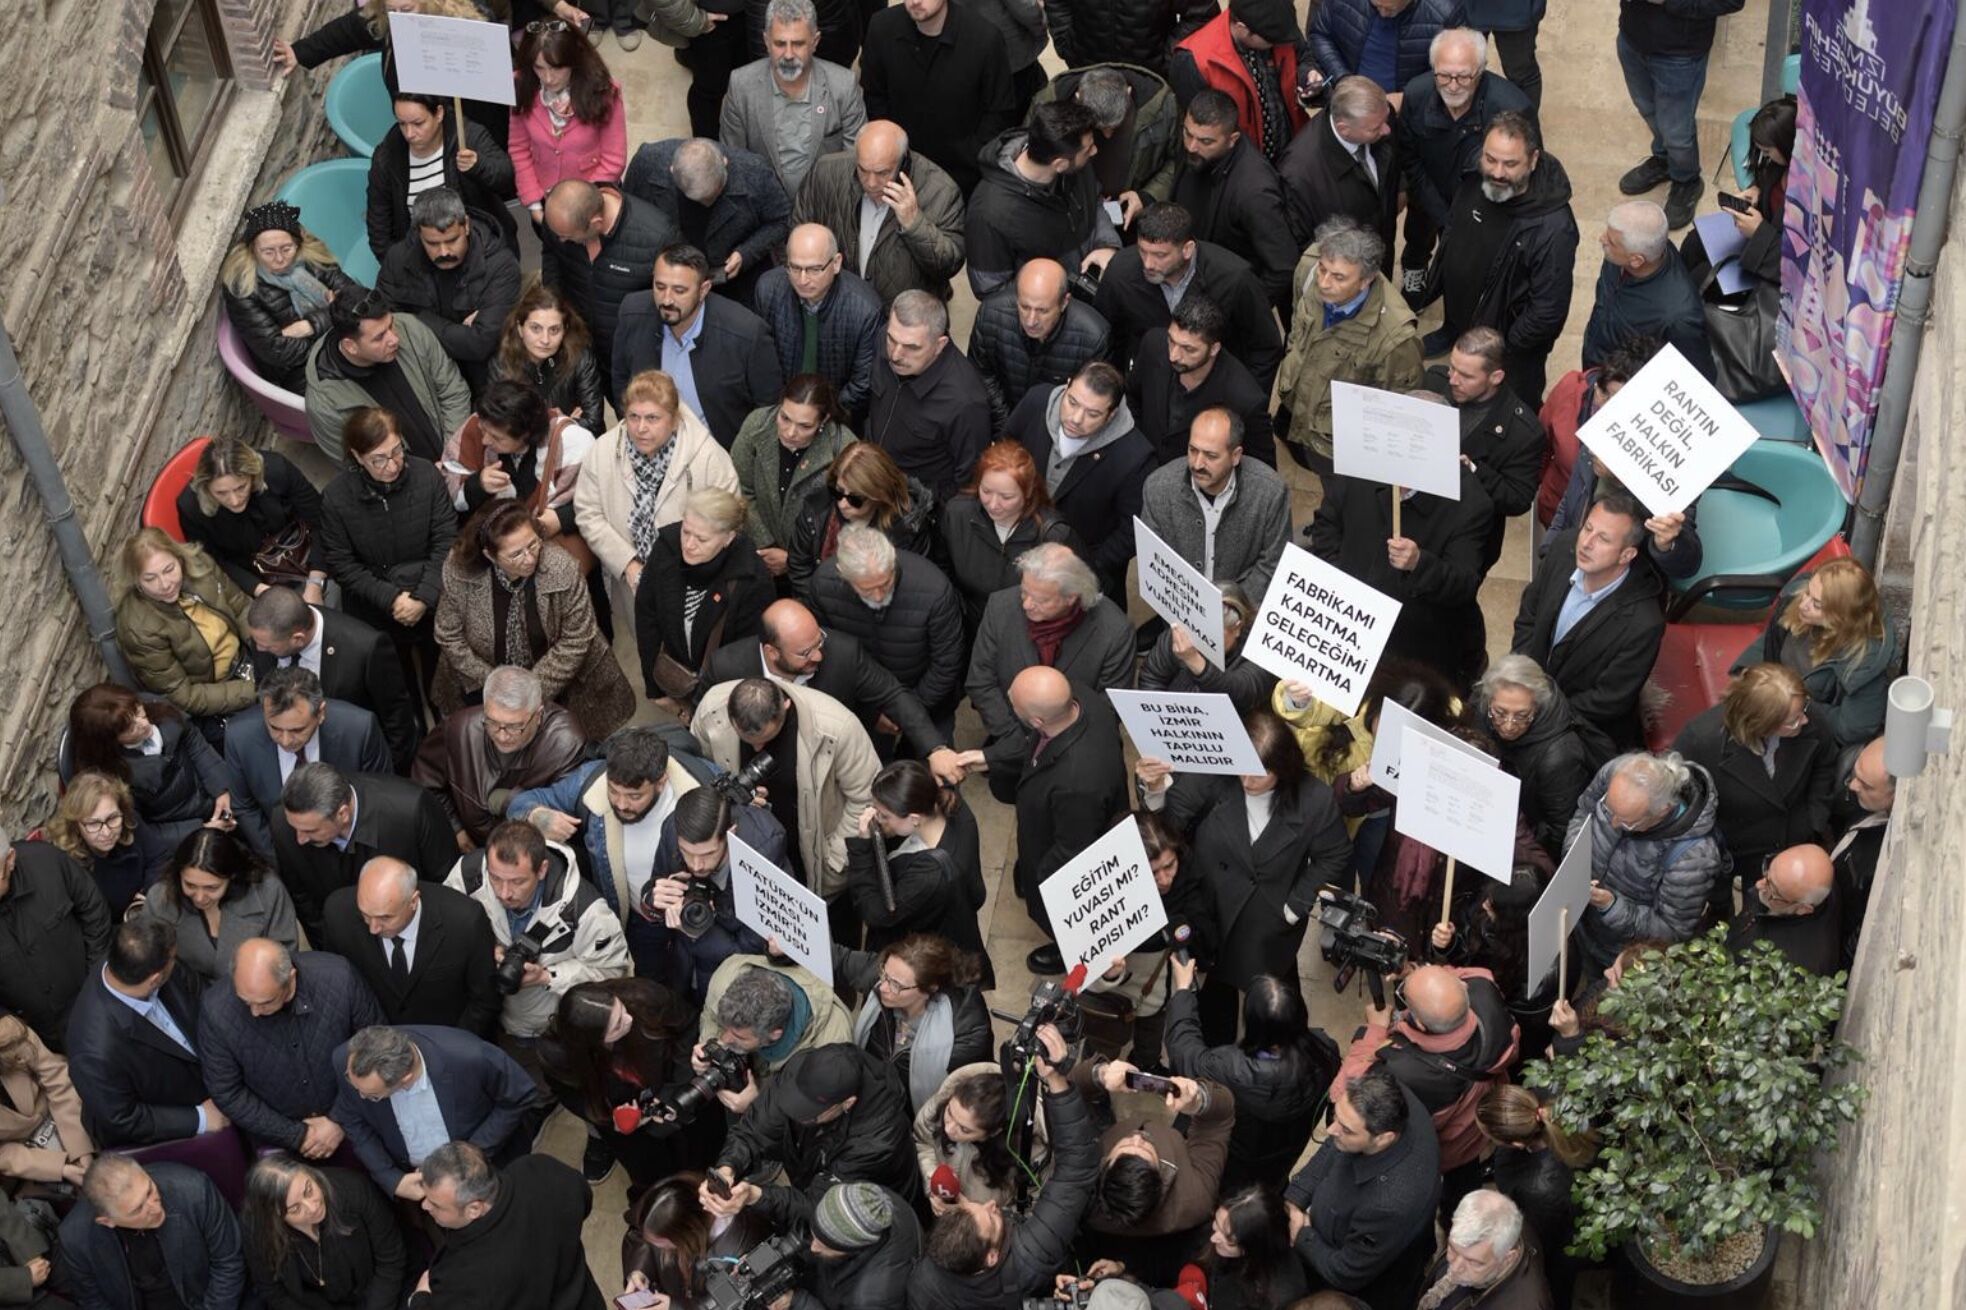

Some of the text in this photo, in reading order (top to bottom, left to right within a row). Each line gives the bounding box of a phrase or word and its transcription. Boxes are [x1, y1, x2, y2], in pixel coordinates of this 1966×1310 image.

[1650, 399, 1693, 451] DEĞİL,
[1663, 379, 1720, 438] RANTIN
[1605, 421, 1680, 497] FABRİKASI
[1629, 412, 1686, 470] HALKIN
[1145, 579, 1217, 652] VURULAMAZ
[1280, 593, 1361, 650] KAPATMA,
[1286, 572, 1376, 630] FABRİKAMI
[1261, 632, 1351, 693] KARARTMA
[1266, 611, 1369, 675] GELECEĞİMİ
[1140, 703, 1162, 713] BU
[1150, 728, 1224, 740] HALKININ
[1159, 715, 1202, 727] İZMİR
[1163, 741, 1223, 753] TAPULU
[1170, 753, 1234, 766] MALIDIR
[738, 859, 819, 924] ATATÜRK'ÜN
[1063, 864, 1139, 930] YUVASI MI?
[1072, 855, 1120, 900] EĞİTİM
[758, 911, 810, 956] TAPUSU
[1079, 904, 1150, 966] KAPISI MI?
[1089, 897, 1126, 935] RANT
